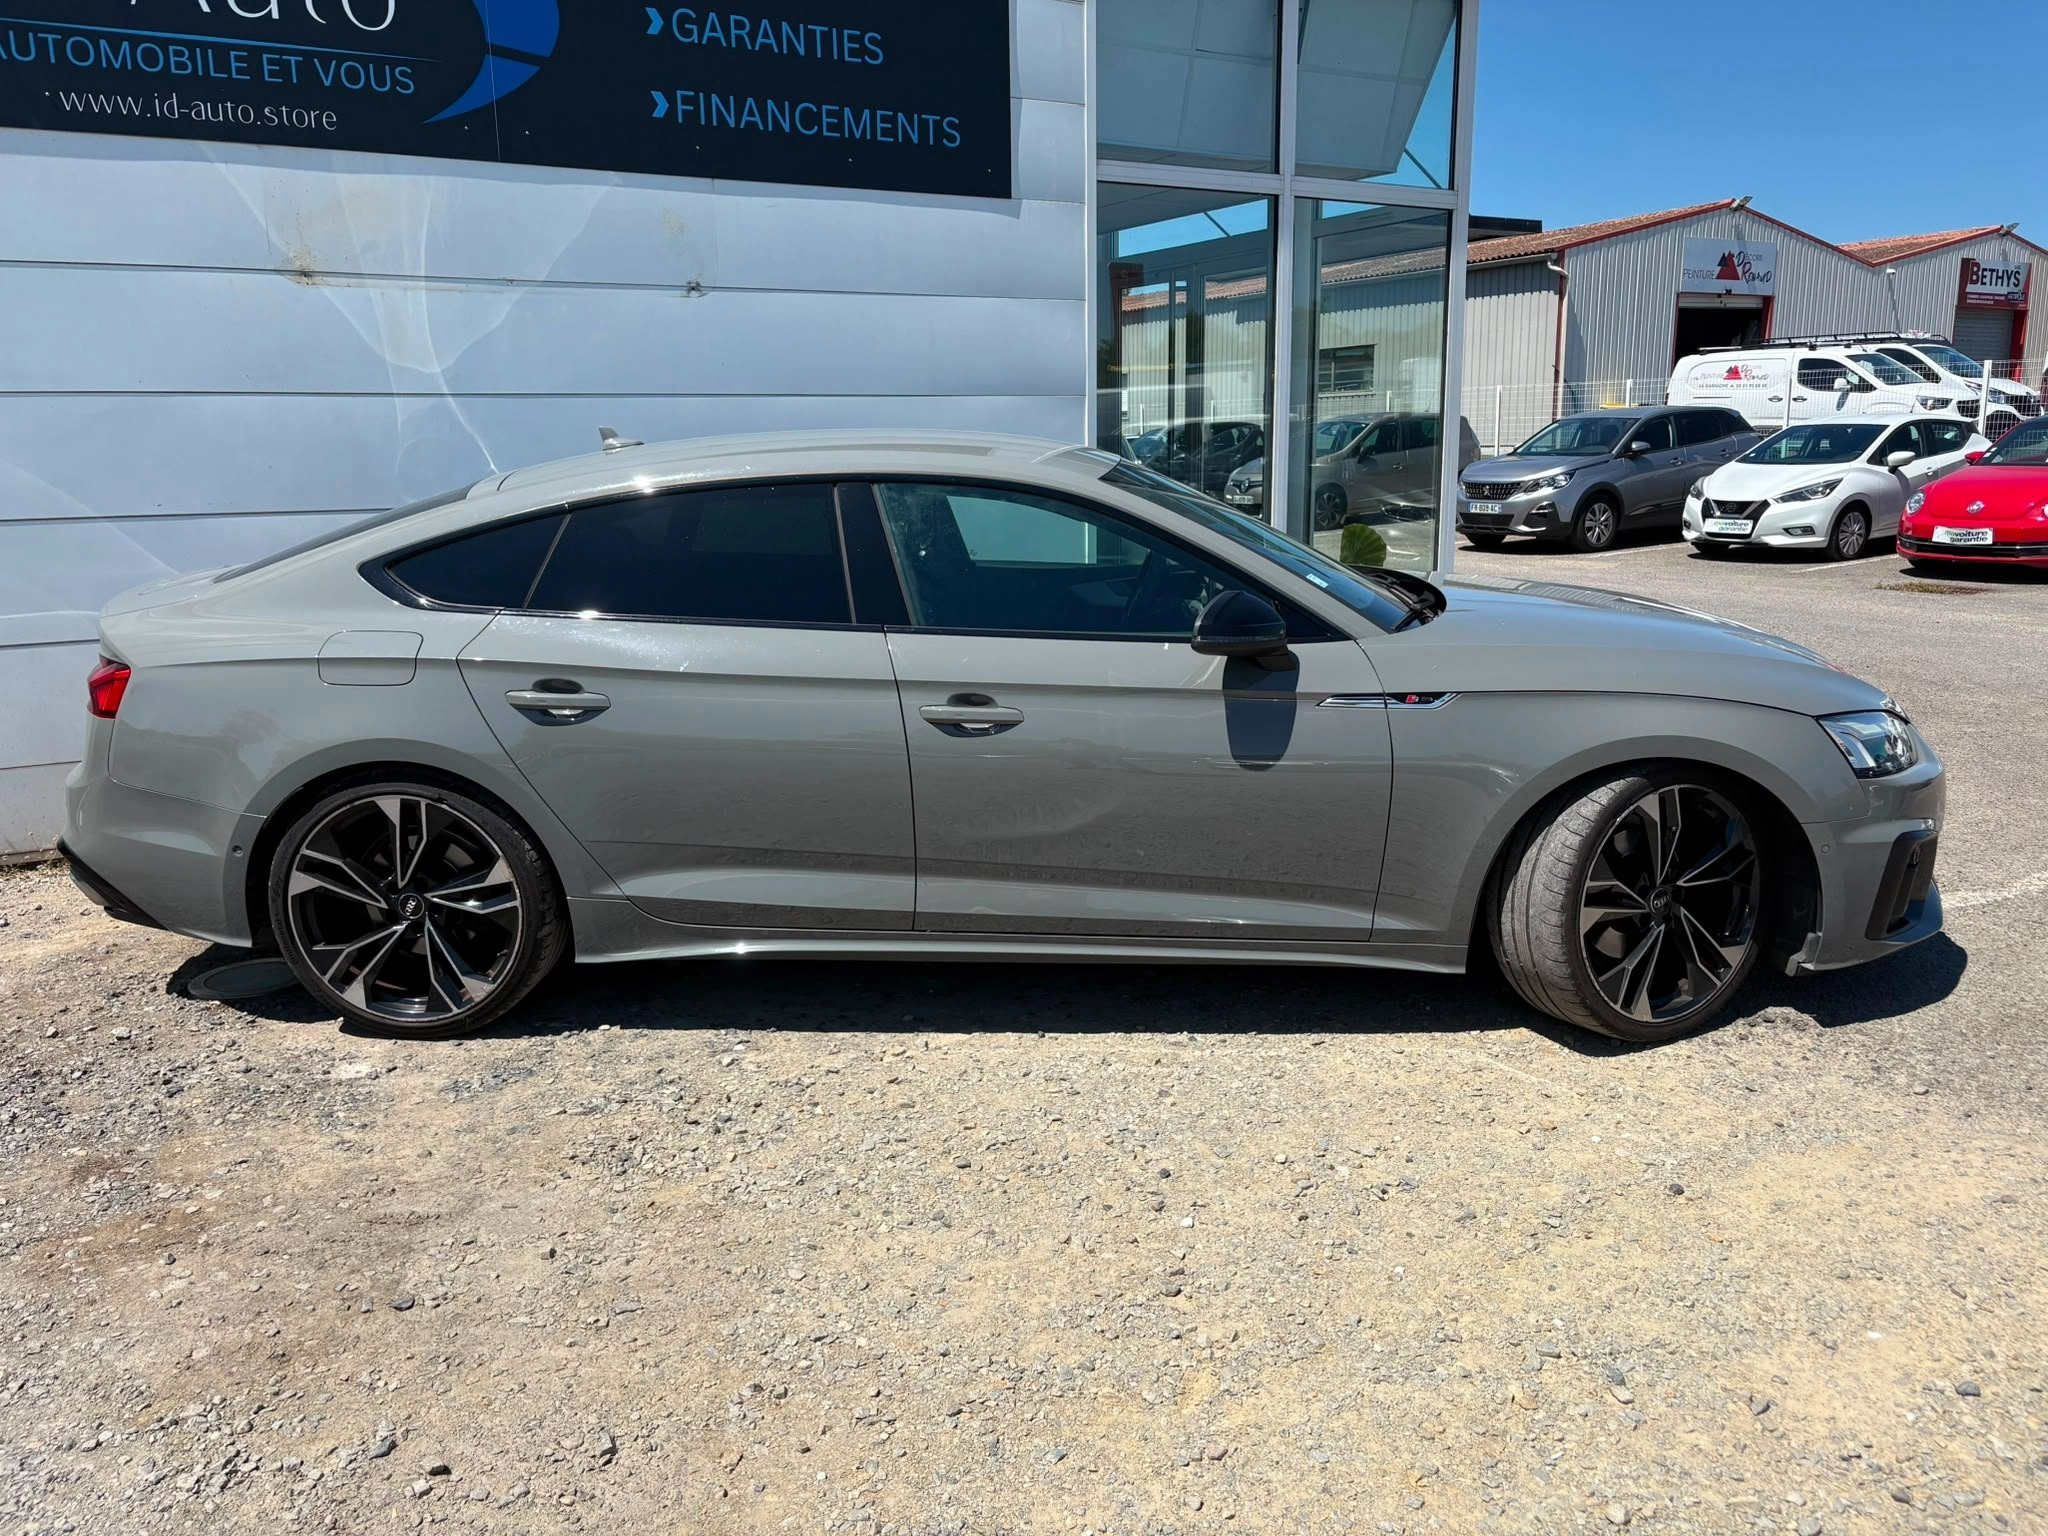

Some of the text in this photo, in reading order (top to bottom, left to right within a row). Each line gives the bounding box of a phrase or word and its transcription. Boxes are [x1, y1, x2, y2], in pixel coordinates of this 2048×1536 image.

[672, 8, 884, 65] GARANTIES
[0, 30, 415, 94] UTOMOBILE ET VOUS
[59, 90, 337, 131] www.id-auto.store
[676, 90, 961, 148] FINANCEMENTS
[1683, 268, 1717, 280] PEINTURE
[1968, 261, 2021, 288] BETHYS
